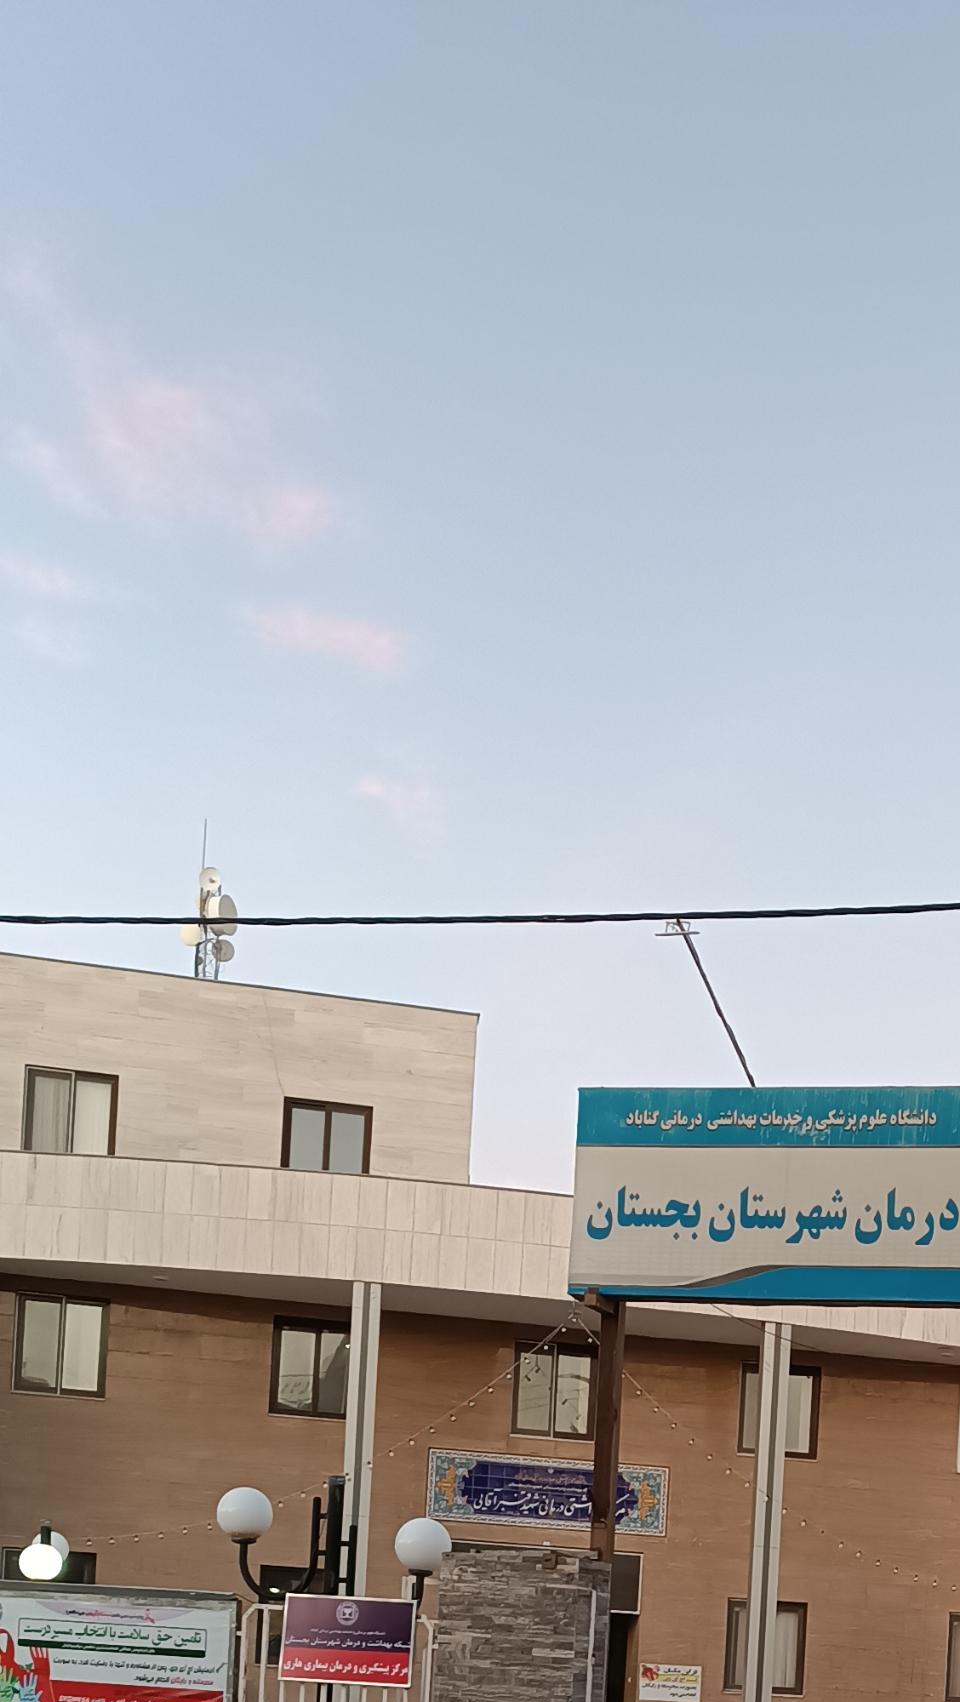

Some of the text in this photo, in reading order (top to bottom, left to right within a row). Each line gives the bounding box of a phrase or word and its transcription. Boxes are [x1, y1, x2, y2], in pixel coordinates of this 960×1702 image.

[625, 1108, 937, 1133] دانشگاه علوم پزشکی و خدمات بهداشتی درمانی گناباد
[586, 1184, 701, 1241] بجستان
[708, 1186, 848, 1244] شهرستان
[854, 1187, 960, 1246] درمان
